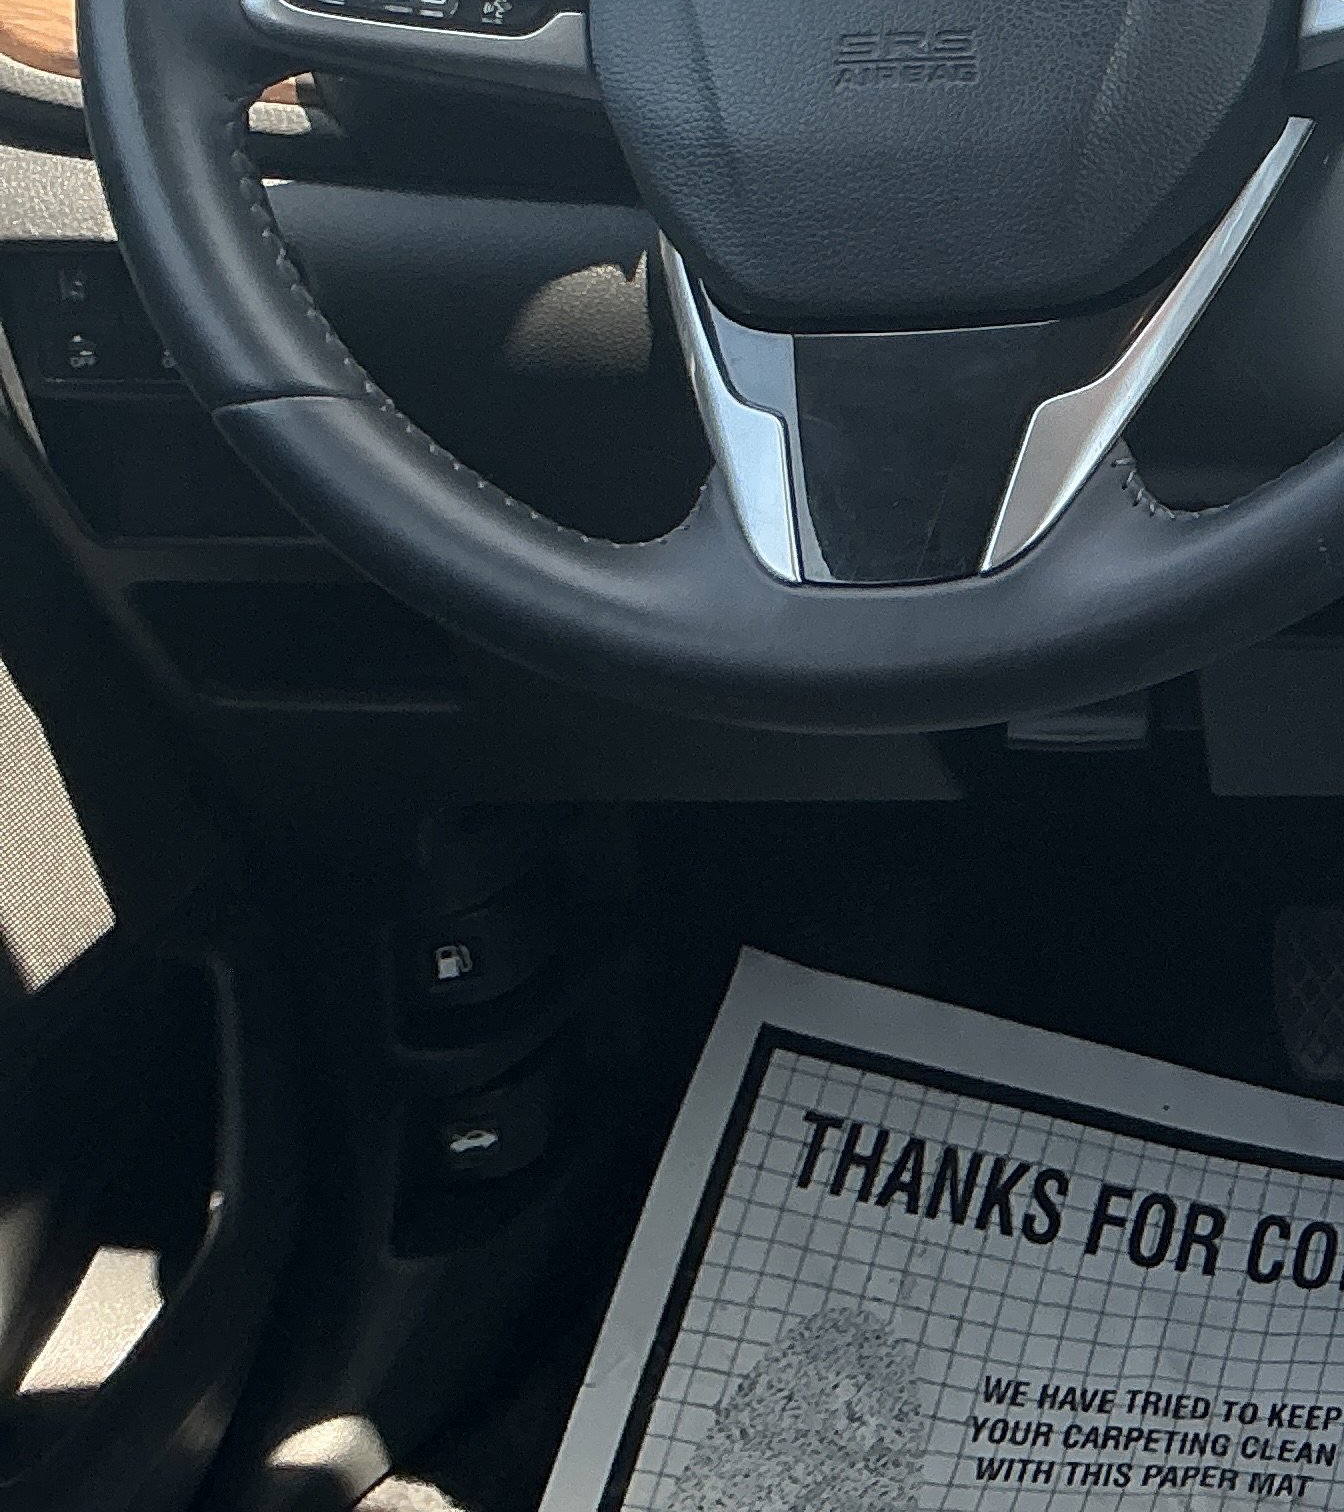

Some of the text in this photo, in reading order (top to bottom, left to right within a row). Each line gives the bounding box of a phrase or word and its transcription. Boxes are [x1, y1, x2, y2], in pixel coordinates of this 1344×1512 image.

[796, 1110, 1070, 1245] THANKS
[1083, 1183, 1227, 1277] FOR
[982, 1375, 1344, 1431] WE HAVE TRIED TO KEEP
[968, 1414, 1337, 1467] YOUR CARPETING CLEAN
[975, 1456, 1315, 1498] WITH THIS PAPER MAT
